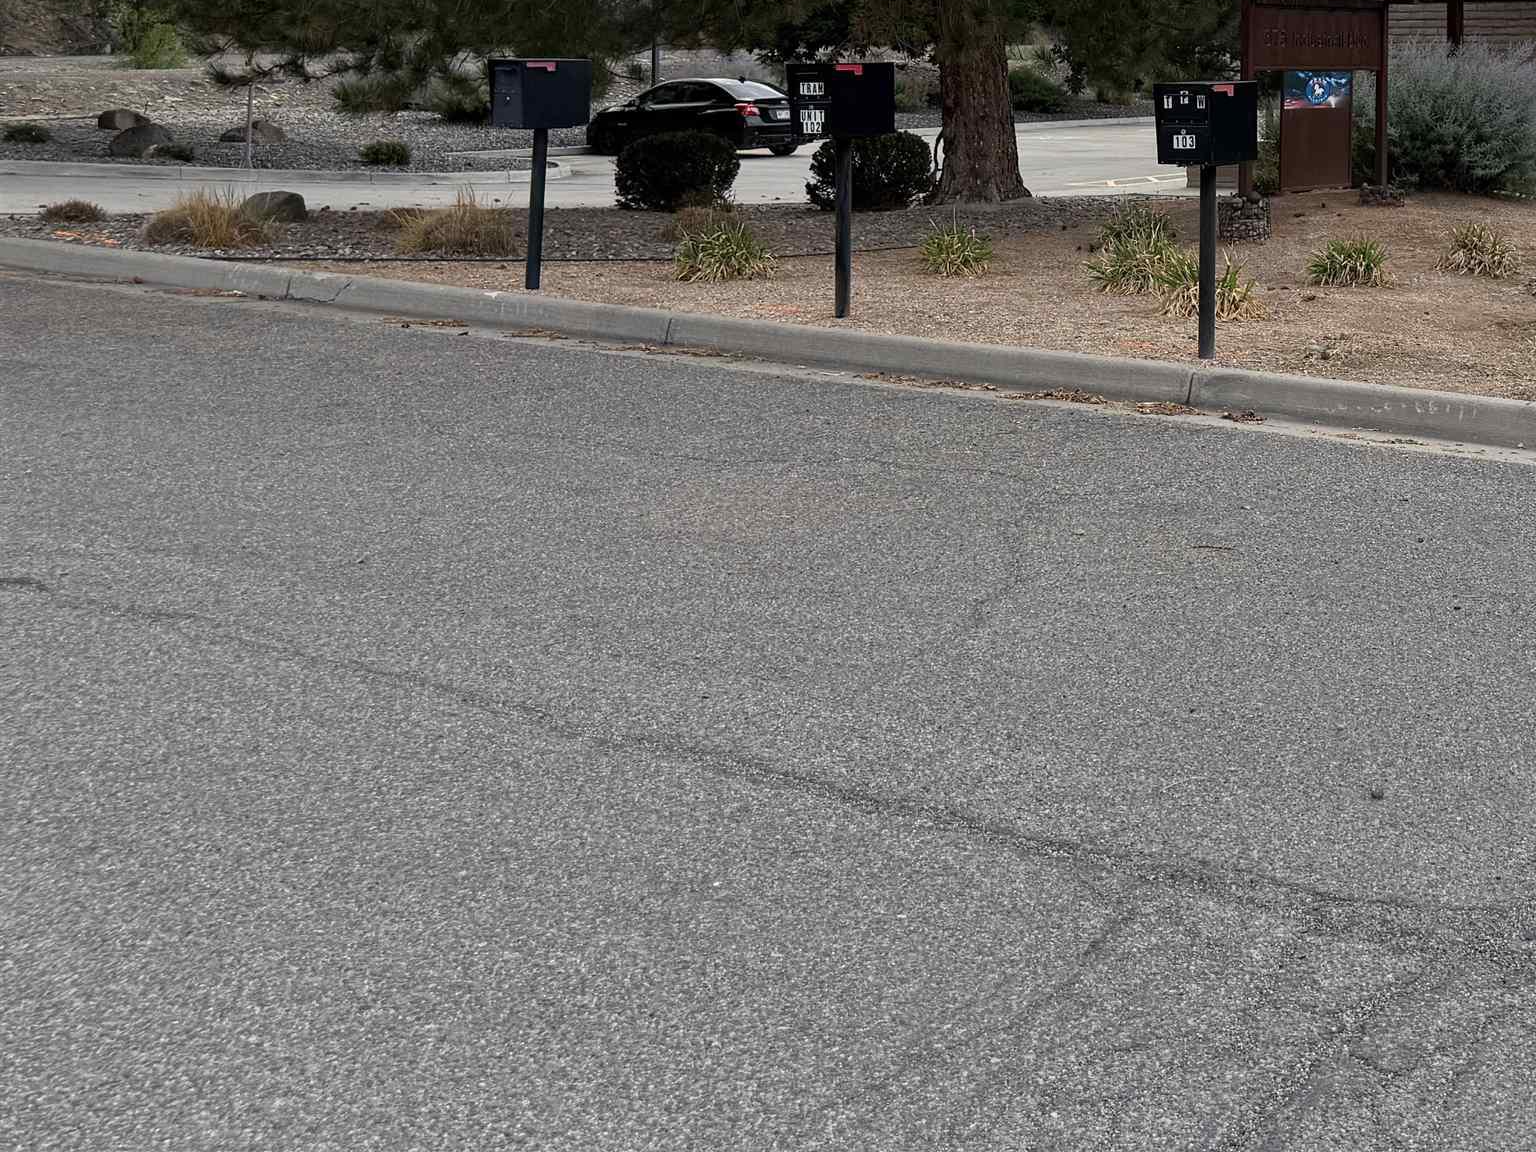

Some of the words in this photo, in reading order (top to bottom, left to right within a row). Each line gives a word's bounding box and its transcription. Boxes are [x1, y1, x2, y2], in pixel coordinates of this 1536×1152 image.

[801, 111, 823, 122] UNIT
[804, 122, 821, 133] 102
[1175, 135, 1195, 148] 103
